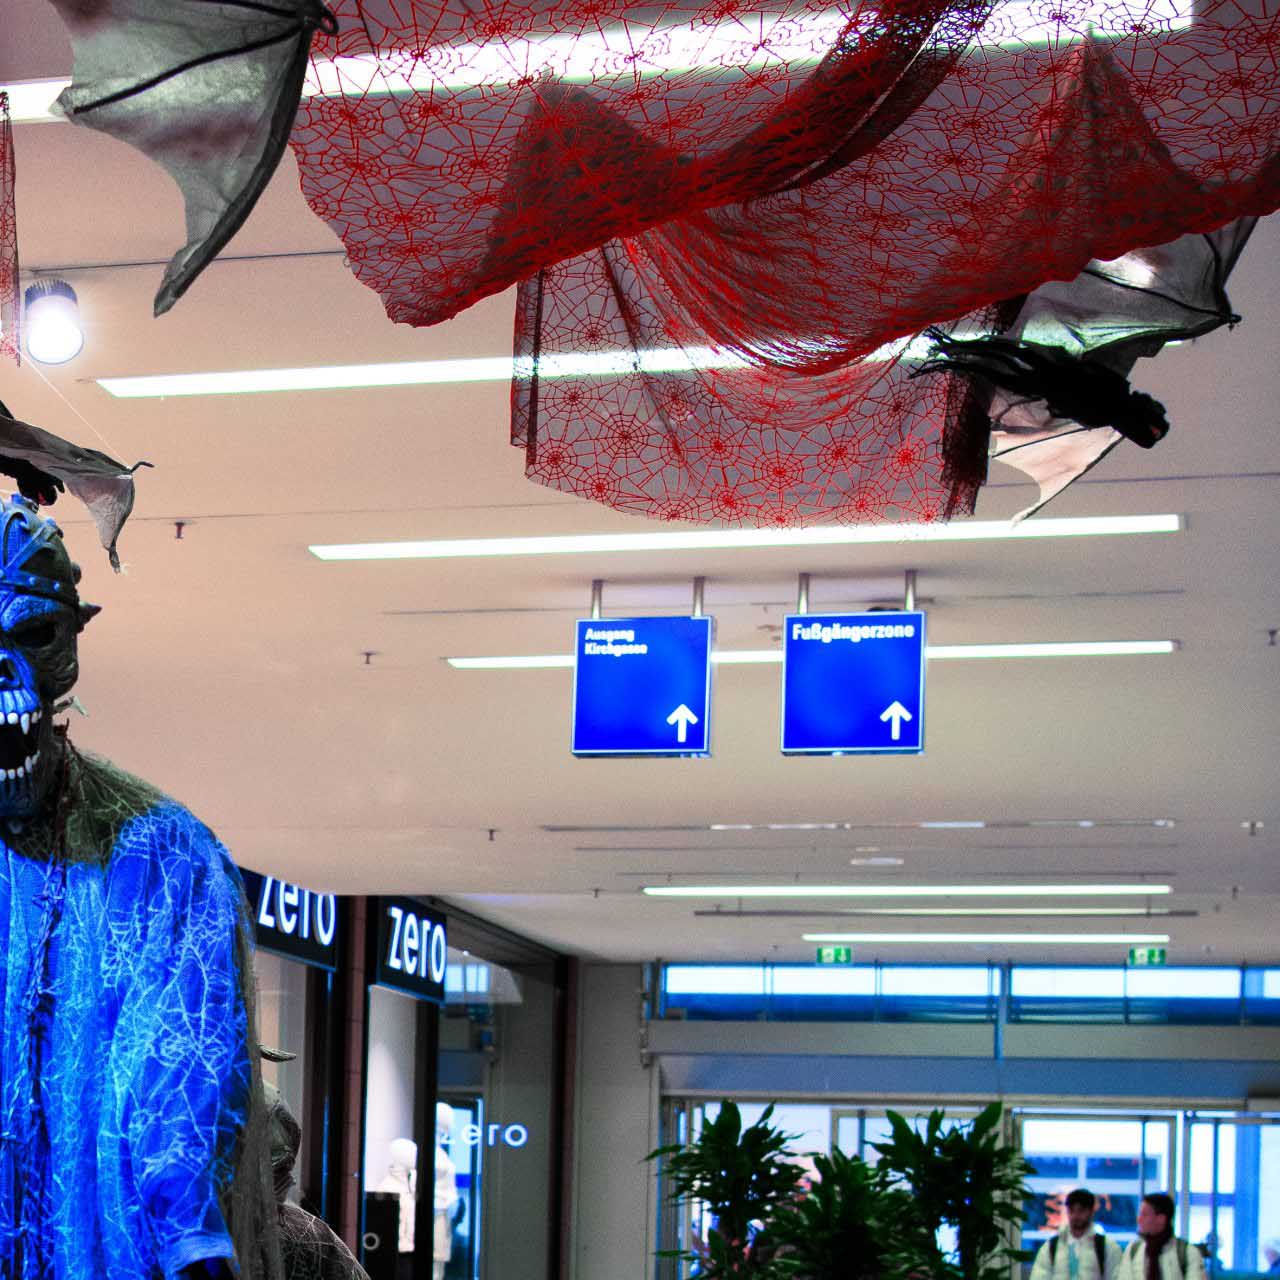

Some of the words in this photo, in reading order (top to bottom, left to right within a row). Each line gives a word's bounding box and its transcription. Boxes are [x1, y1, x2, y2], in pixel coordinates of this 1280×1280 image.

[791, 622, 915, 643] Fußgängerzone
[257, 875, 337, 946] zero
[387, 905, 448, 984] zero
